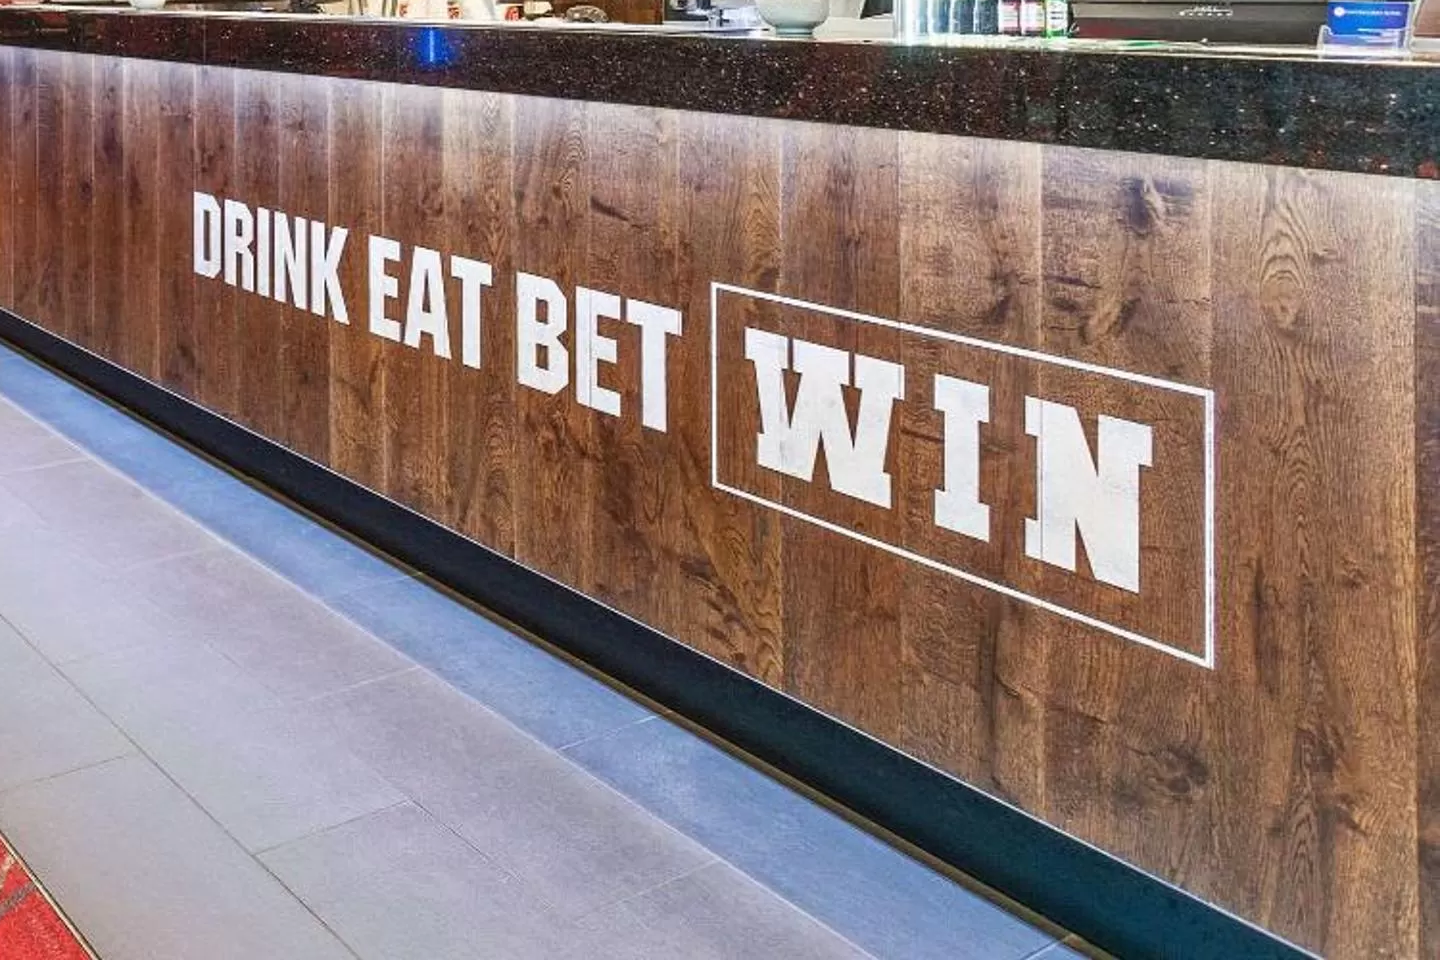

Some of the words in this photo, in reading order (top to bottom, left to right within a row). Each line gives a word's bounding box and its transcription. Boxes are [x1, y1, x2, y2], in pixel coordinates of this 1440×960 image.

[194, 191, 350, 326] DRINK
[368, 235, 494, 370] EAT
[516, 271, 683, 434] BET
[744, 327, 1153, 594] WIN
